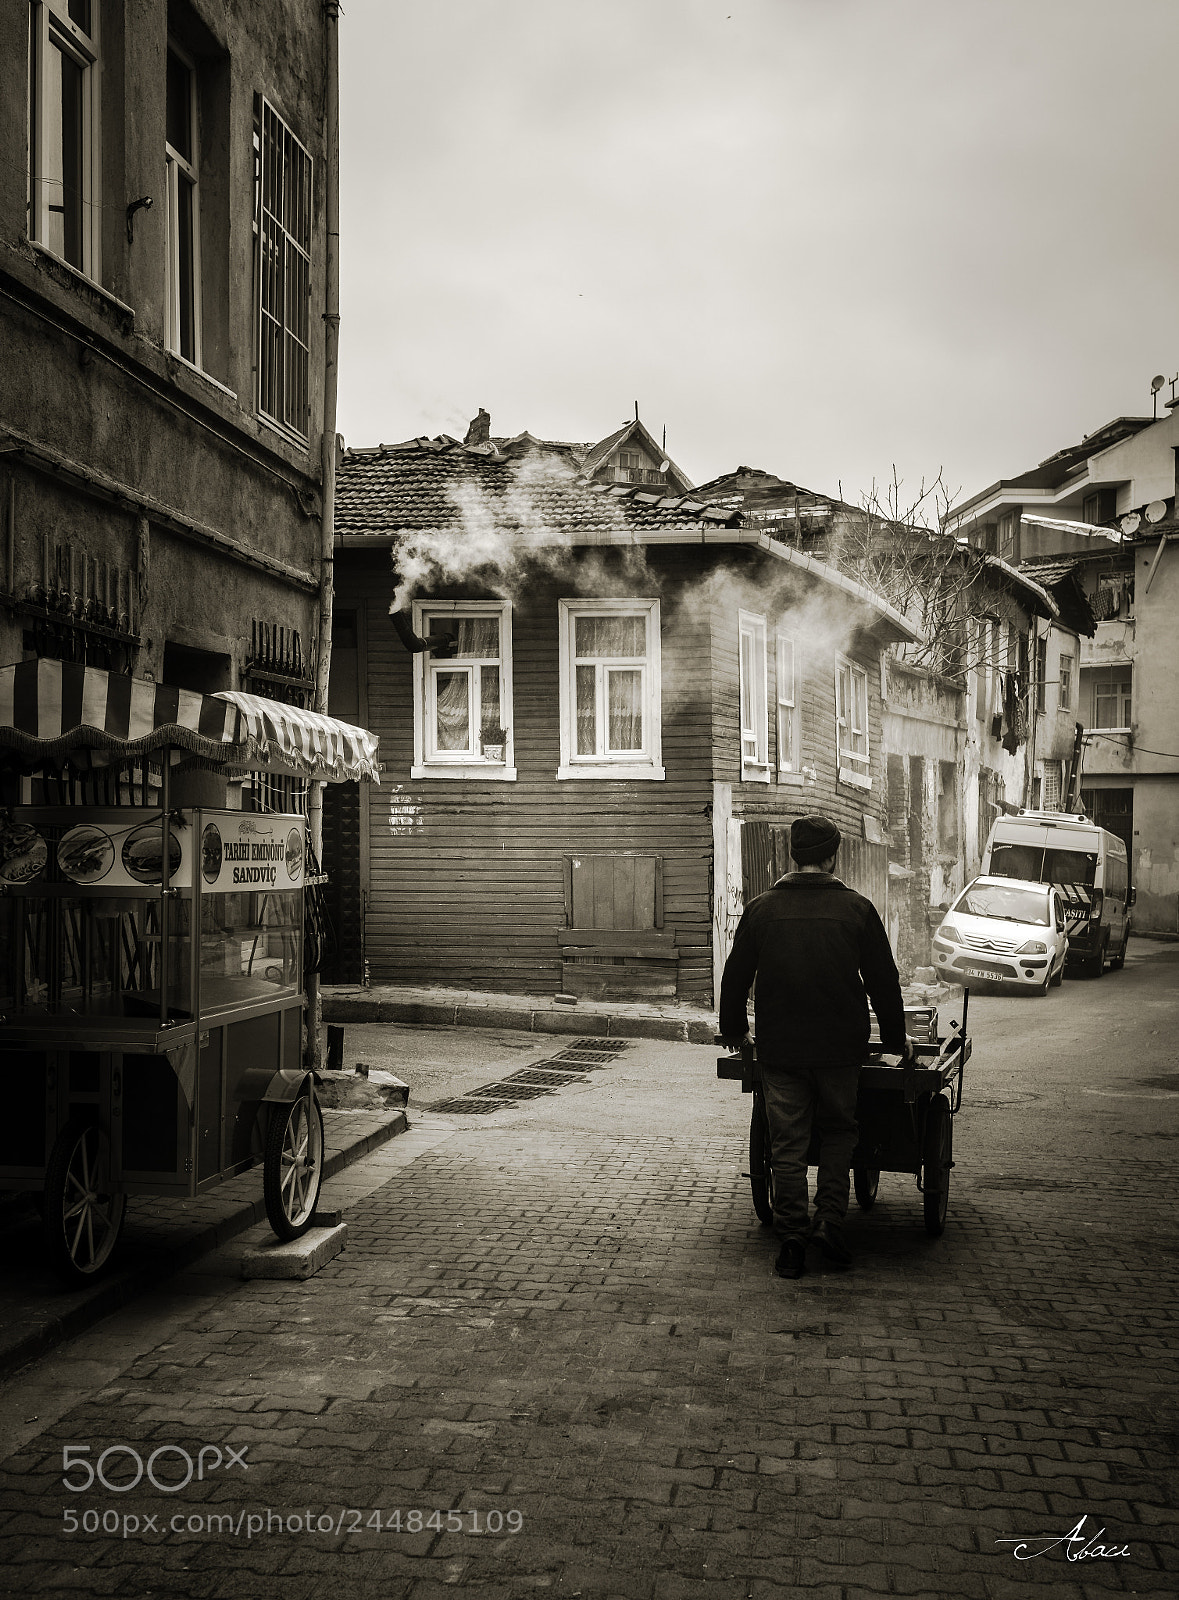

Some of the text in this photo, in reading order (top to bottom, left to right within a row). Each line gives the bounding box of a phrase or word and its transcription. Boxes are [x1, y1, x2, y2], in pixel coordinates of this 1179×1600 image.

[223, 837, 285, 861] TARİHİ EMİNÖNÜ
[233, 863, 277, 887] SANDVİÇ
